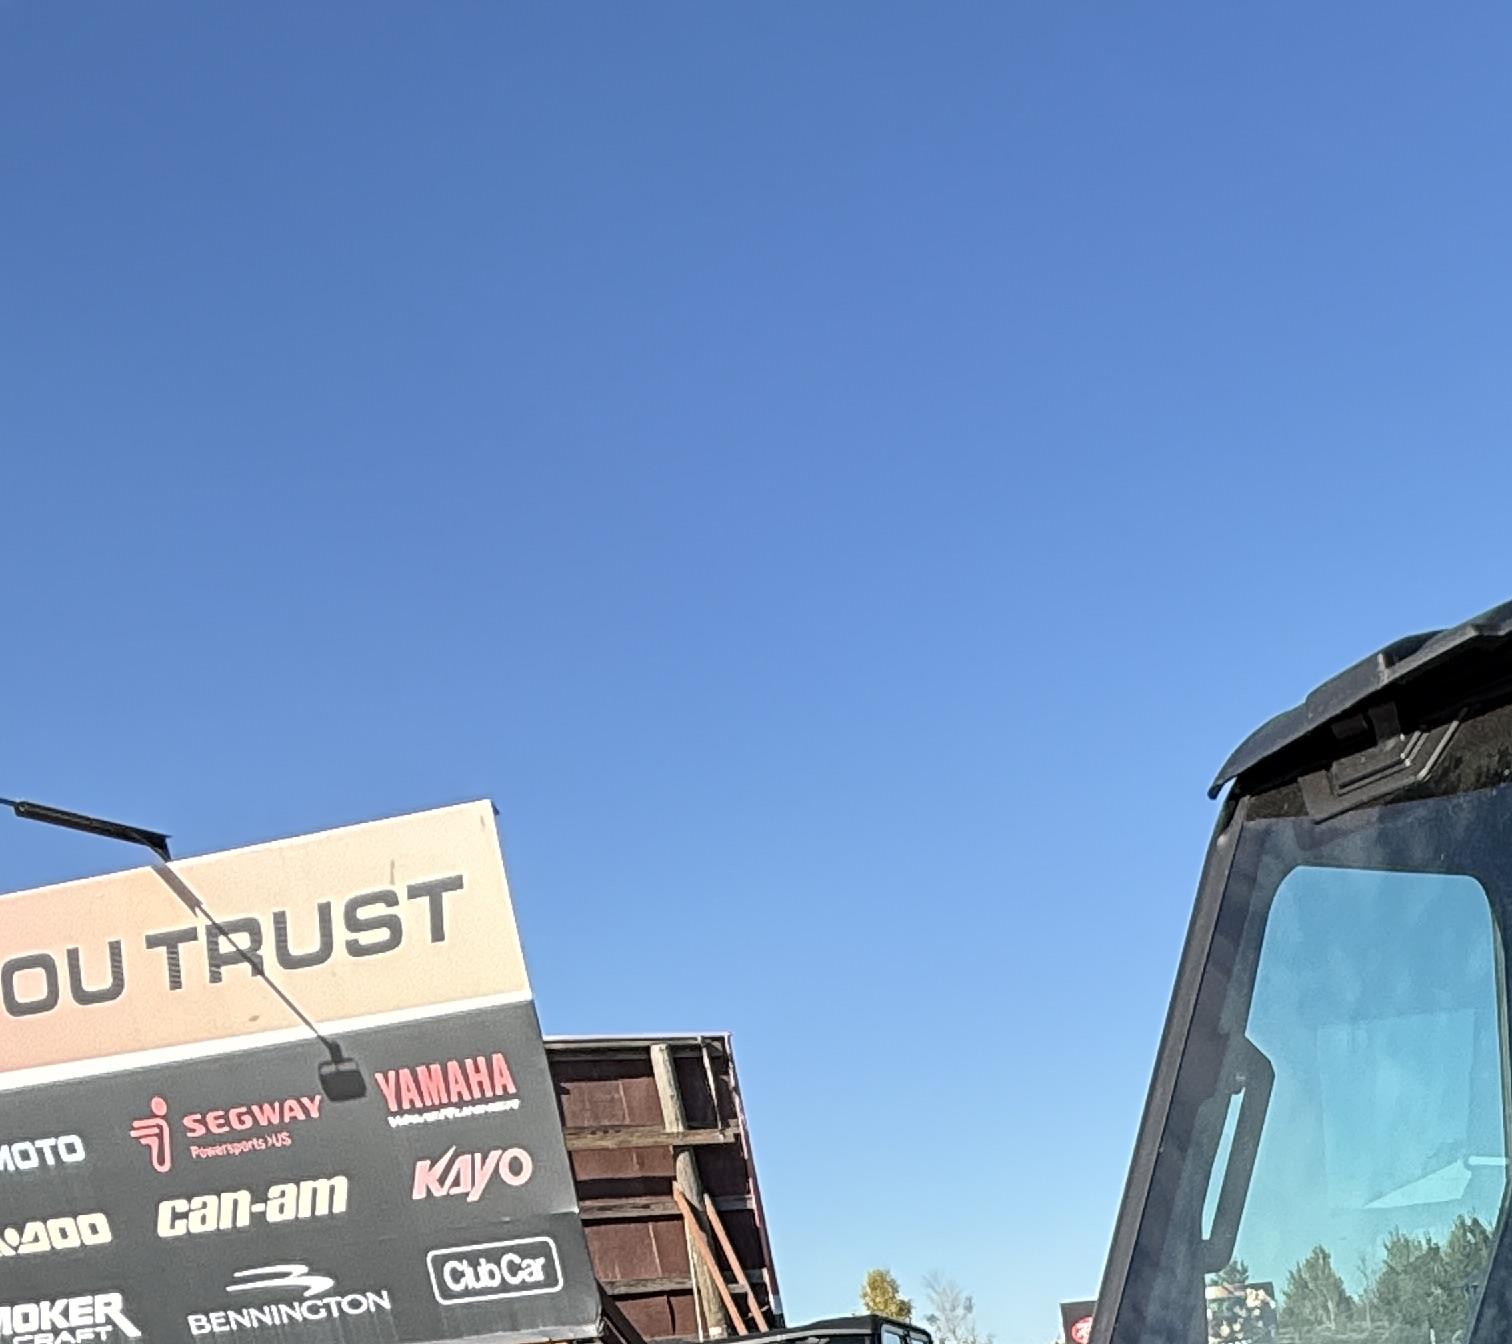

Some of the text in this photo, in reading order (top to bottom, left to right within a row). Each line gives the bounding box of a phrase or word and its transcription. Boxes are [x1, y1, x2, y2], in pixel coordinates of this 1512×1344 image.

[145, 874, 464, 991] TRUST
[375, 1053, 517, 1111] YAMAHA
[182, 1095, 322, 1137] SEGWAY
[412, 1145, 533, 1202] KAYO
[158, 1175, 348, 1237] can-am
[443, 1253, 546, 1291] Club Car
[187, 1290, 391, 1335] BENNINGTON
